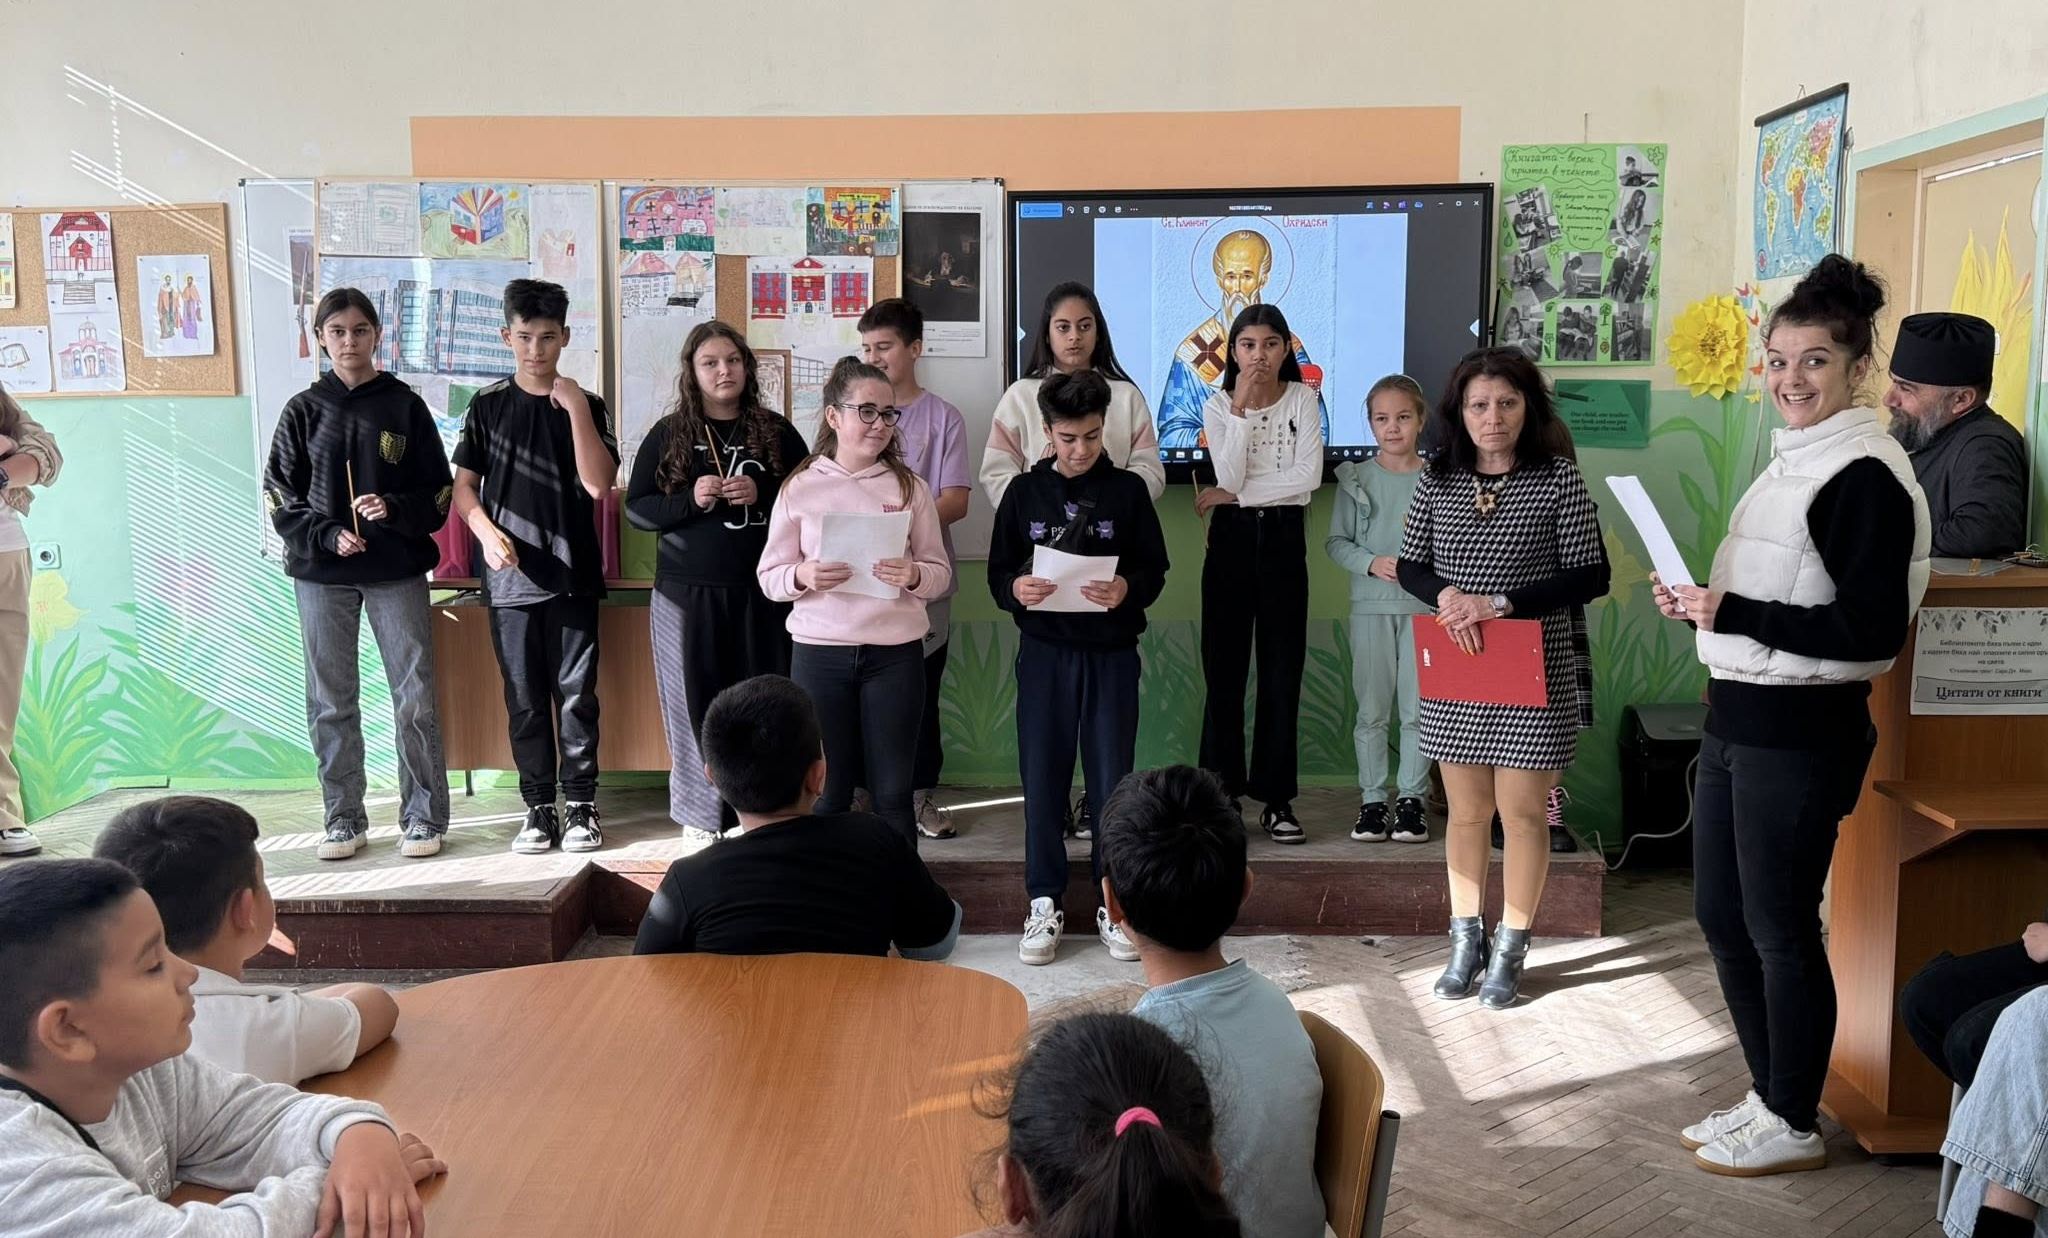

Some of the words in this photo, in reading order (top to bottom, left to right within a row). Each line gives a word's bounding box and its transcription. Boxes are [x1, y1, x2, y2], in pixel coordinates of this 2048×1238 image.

[1936, 686, 1985, 700] Цитати
[1987, 689, 2002, 698] от
[2003, 689, 2042, 698] книги
